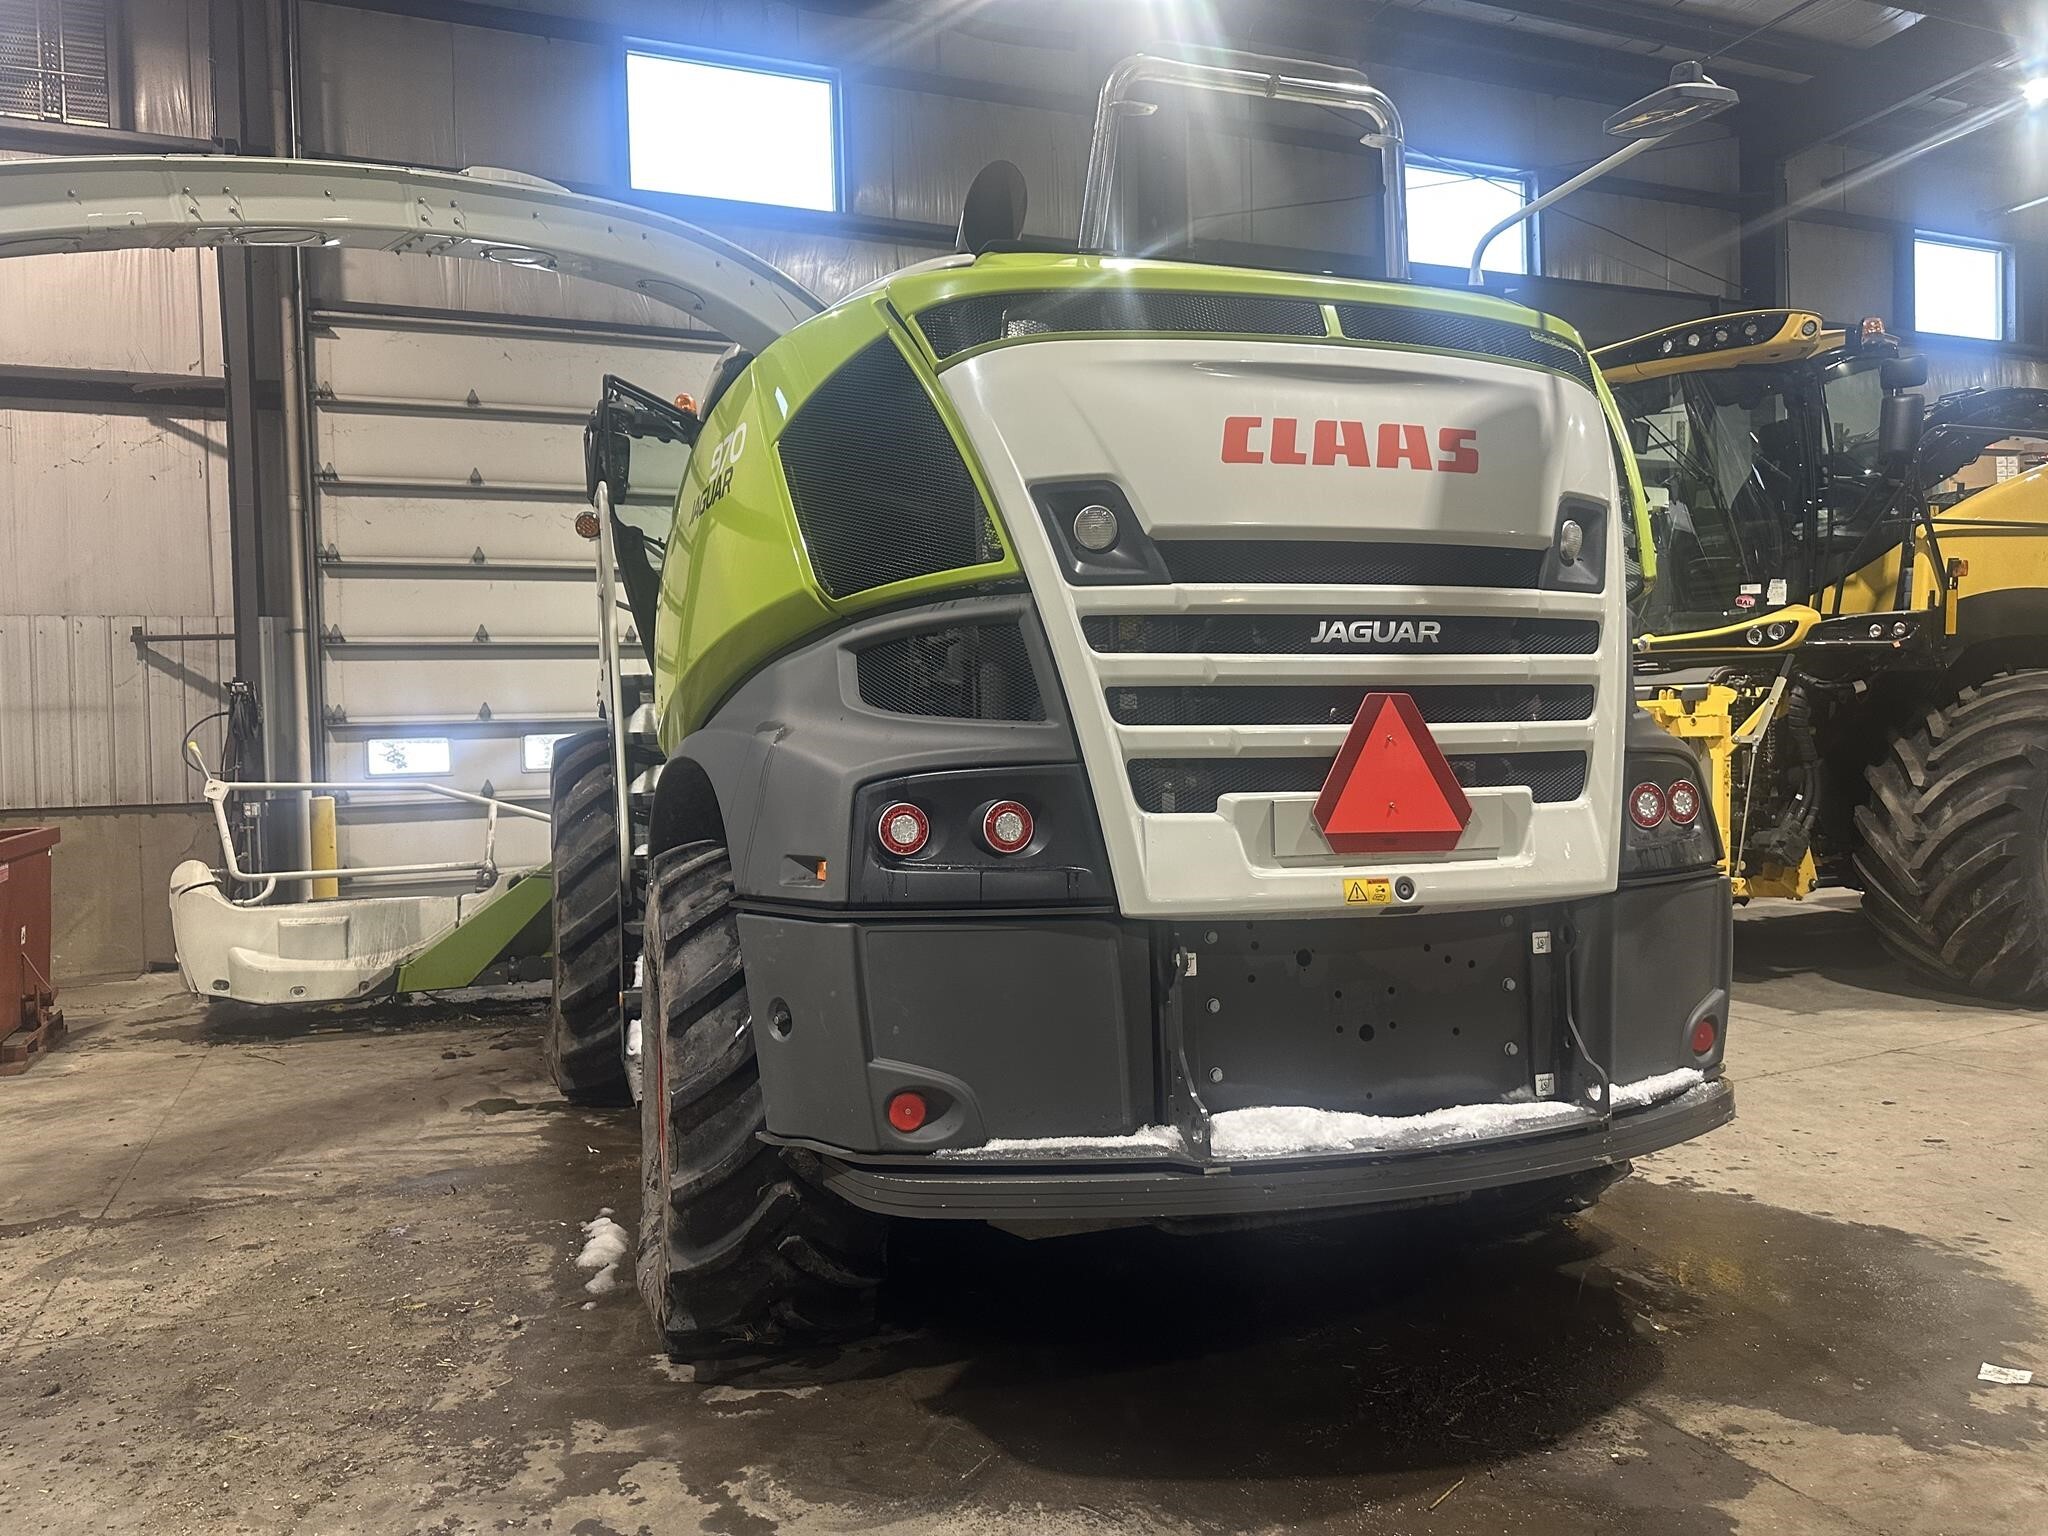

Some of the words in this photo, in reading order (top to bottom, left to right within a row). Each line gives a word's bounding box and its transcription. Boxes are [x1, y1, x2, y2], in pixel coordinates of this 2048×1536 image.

[709, 422, 748, 484] 970
[1221, 416, 1479, 474] CLAAS
[688, 466, 734, 527] JAGUAR
[1310, 620, 1441, 643] JAGUAR
